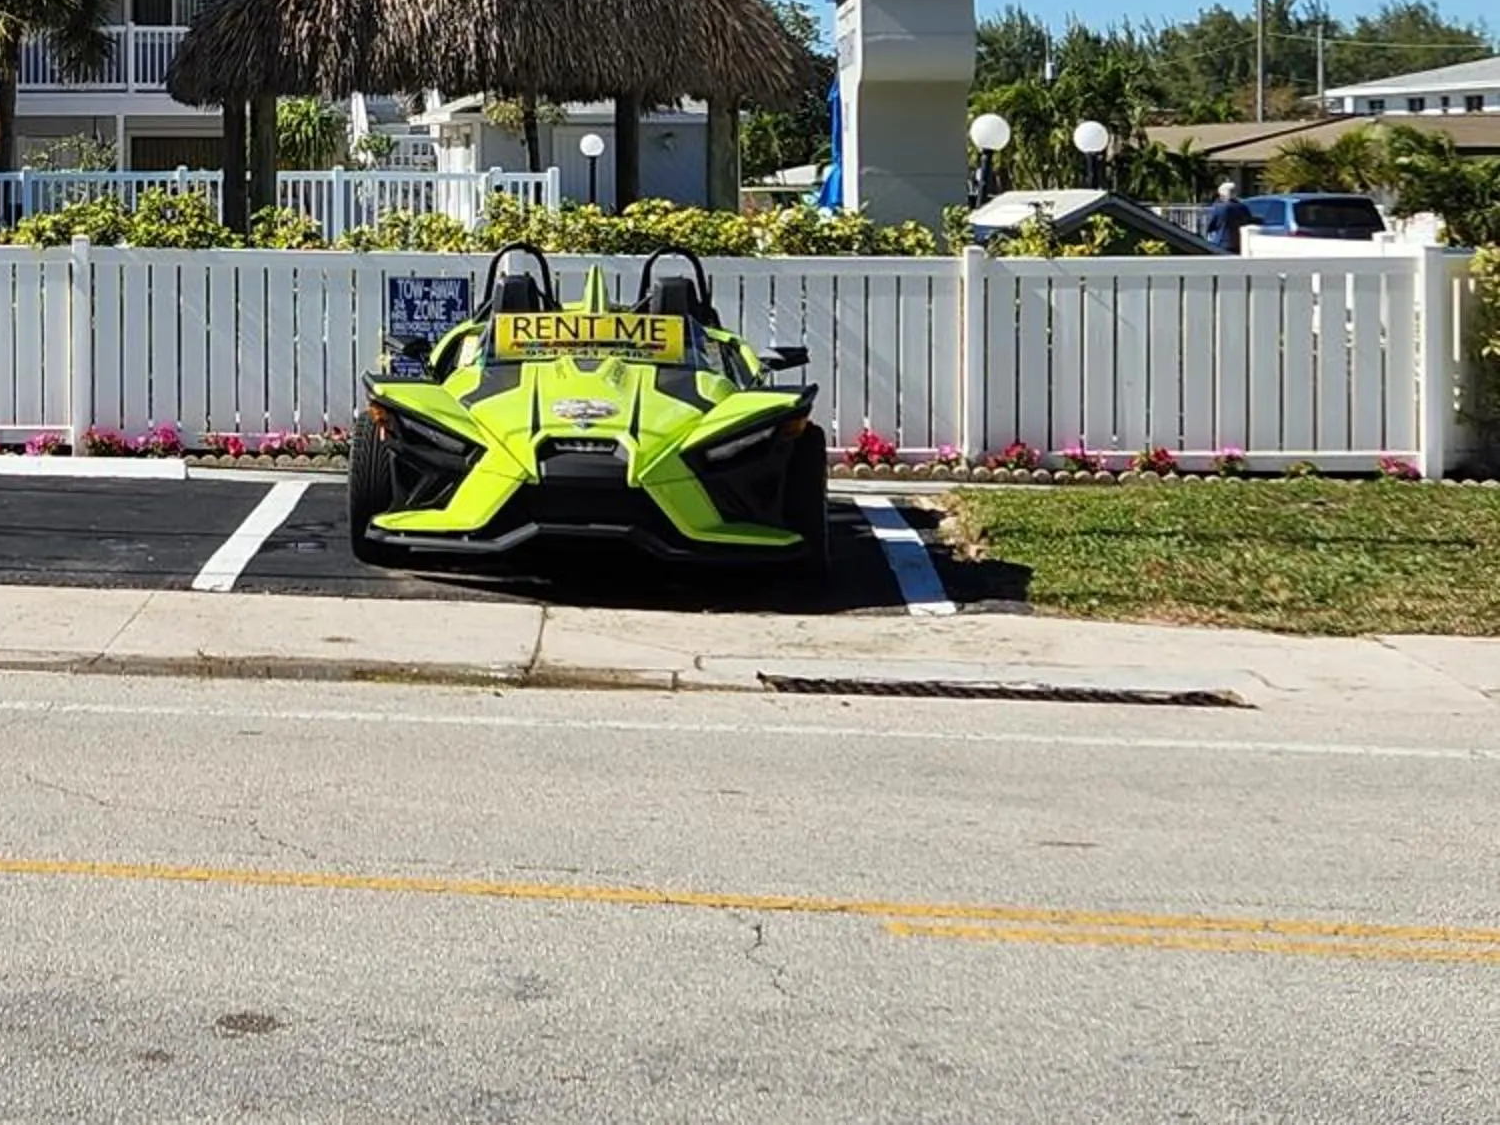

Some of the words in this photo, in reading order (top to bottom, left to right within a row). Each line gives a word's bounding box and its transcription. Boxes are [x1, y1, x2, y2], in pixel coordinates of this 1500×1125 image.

[396, 279, 462, 300] TOW-AWAY
[413, 300, 448, 321] ZONE
[512, 315, 606, 341] RENT
[614, 316, 668, 343] ME
